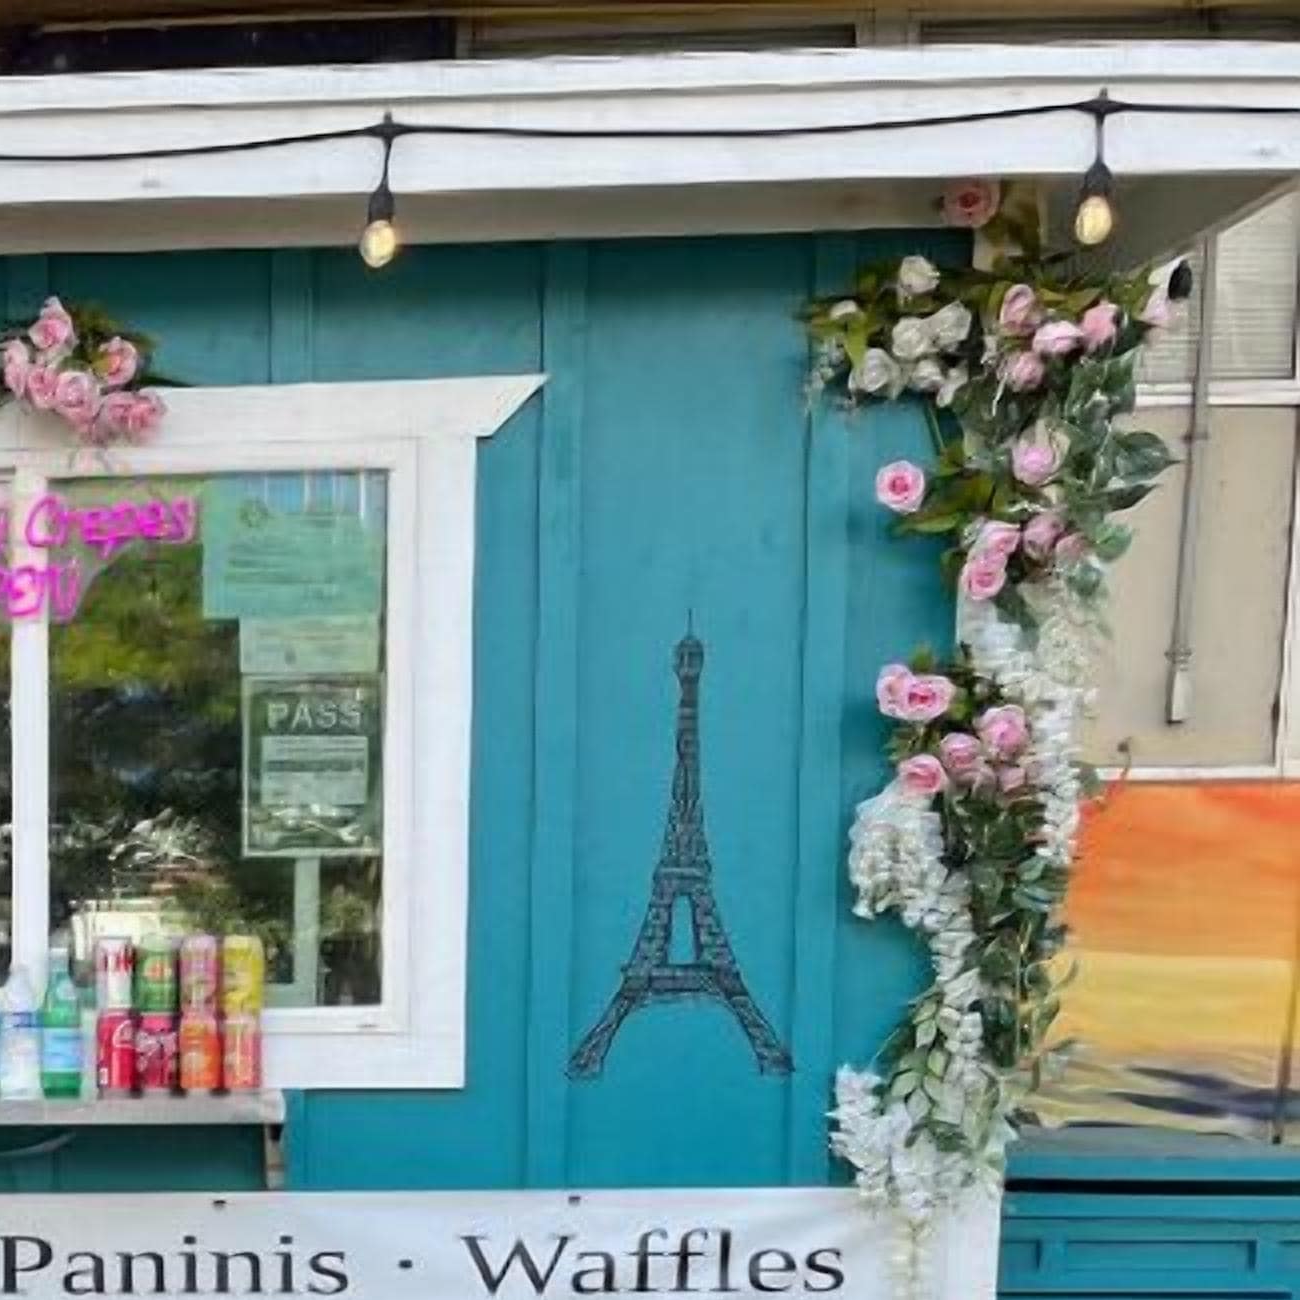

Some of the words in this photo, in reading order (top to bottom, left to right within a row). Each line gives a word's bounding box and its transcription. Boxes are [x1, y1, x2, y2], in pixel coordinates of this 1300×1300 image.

[25, 494, 196, 560] Crepes
[267, 701, 362, 730] PASS
[460, 1228, 846, 1297] Waffles
